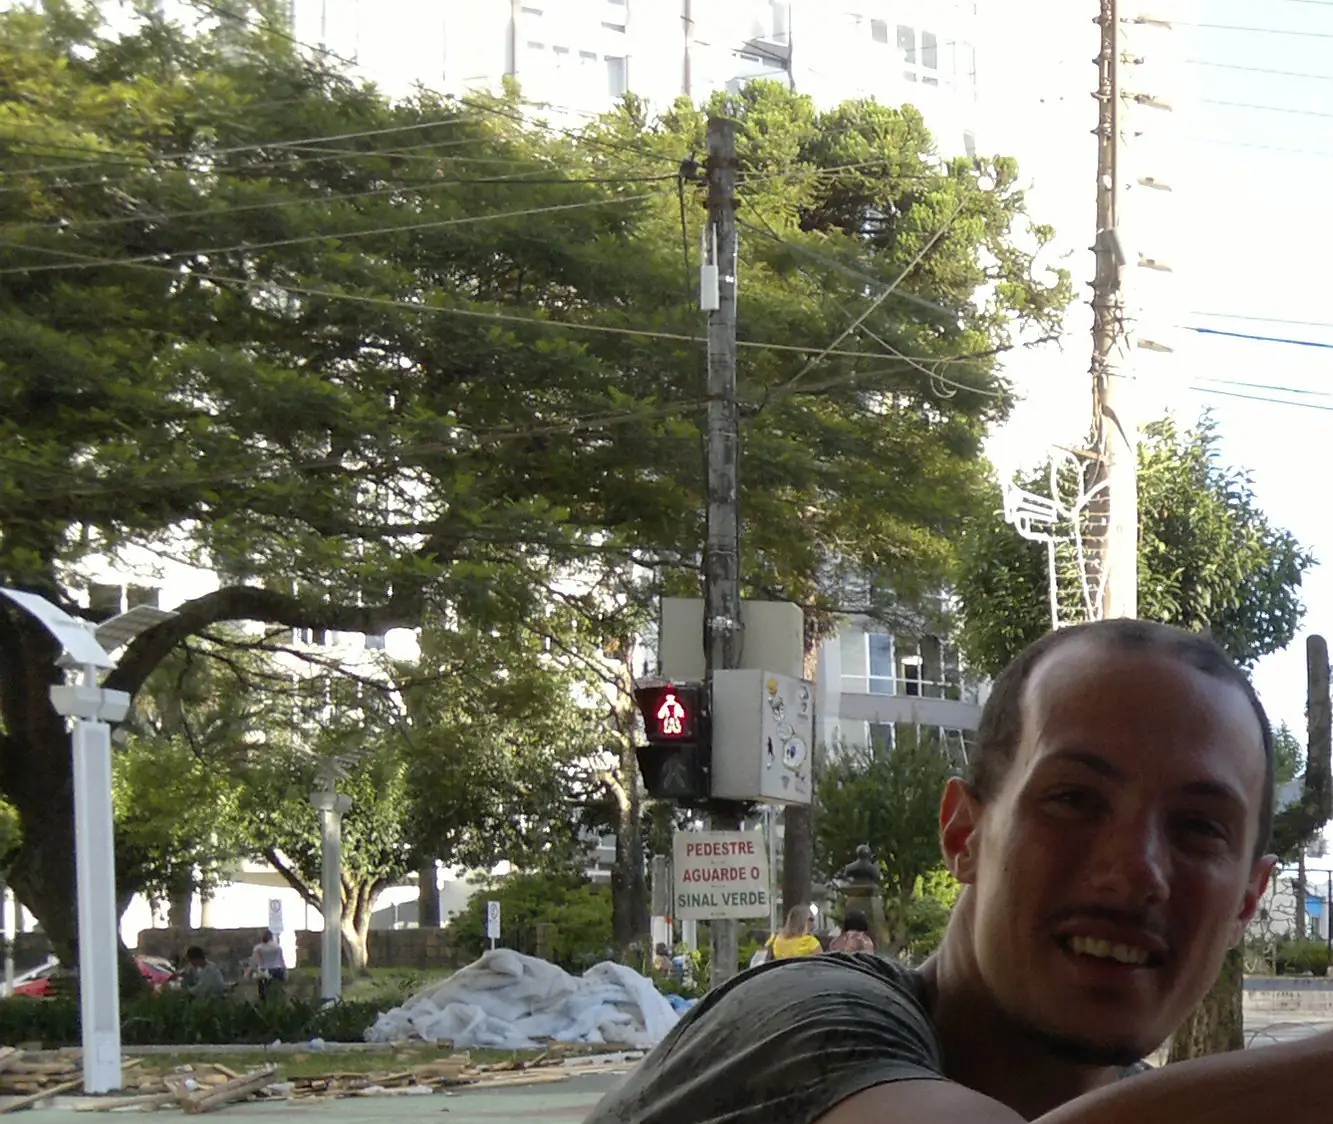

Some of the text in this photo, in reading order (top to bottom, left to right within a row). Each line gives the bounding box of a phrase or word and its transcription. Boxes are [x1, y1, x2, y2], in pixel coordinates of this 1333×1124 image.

[686, 841, 755, 857] PEDESTRE
[682, 866, 760, 882] AGUARDE O
[678, 891, 766, 908] SINAL VERDE
